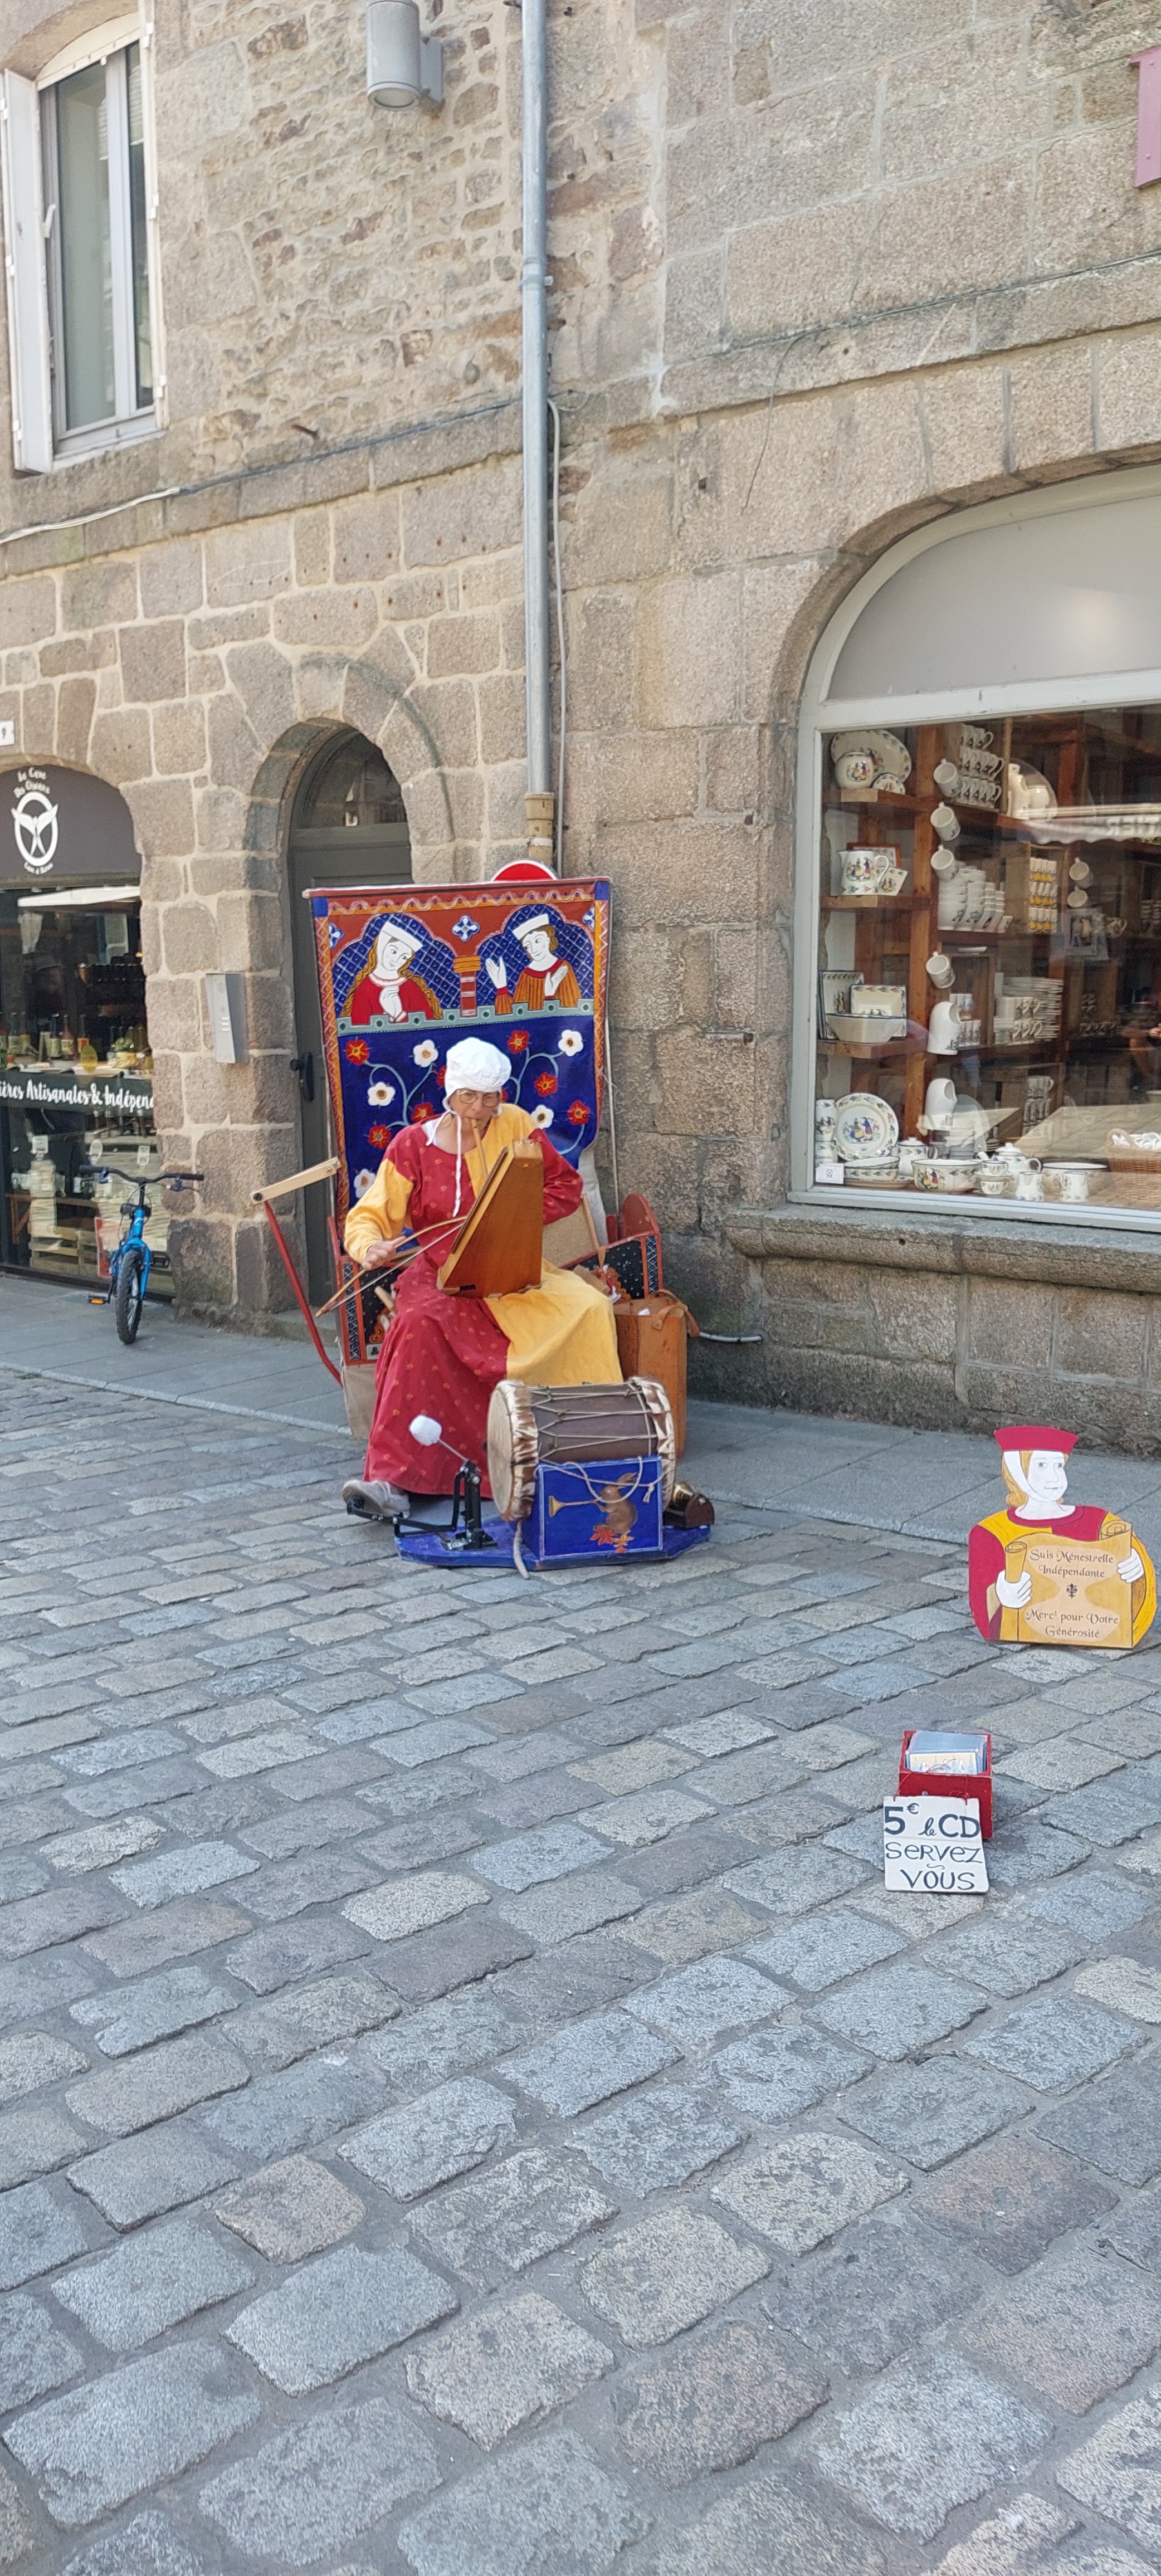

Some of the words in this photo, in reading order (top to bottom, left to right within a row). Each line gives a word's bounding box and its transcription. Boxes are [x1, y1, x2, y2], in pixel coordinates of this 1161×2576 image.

[26, 1079, 89, 1105] Artisanales
[90, 1082, 103, 1105] &
[1030, 1549, 1053, 1560] Suis
[1056, 1551, 1114, 1563] Ménestrelle
[1038, 1565, 1105, 1578] Indépendante
[1026, 1608, 1057, 1621] Merci
[1061, 1614, 1083, 1623] pour
[1086, 1613, 1118, 1624] Votre
[1045, 1626, 1100, 1638] Générosité
[938, 1814, 980, 1838] CD
[900, 1869, 975, 1890] VOUS
